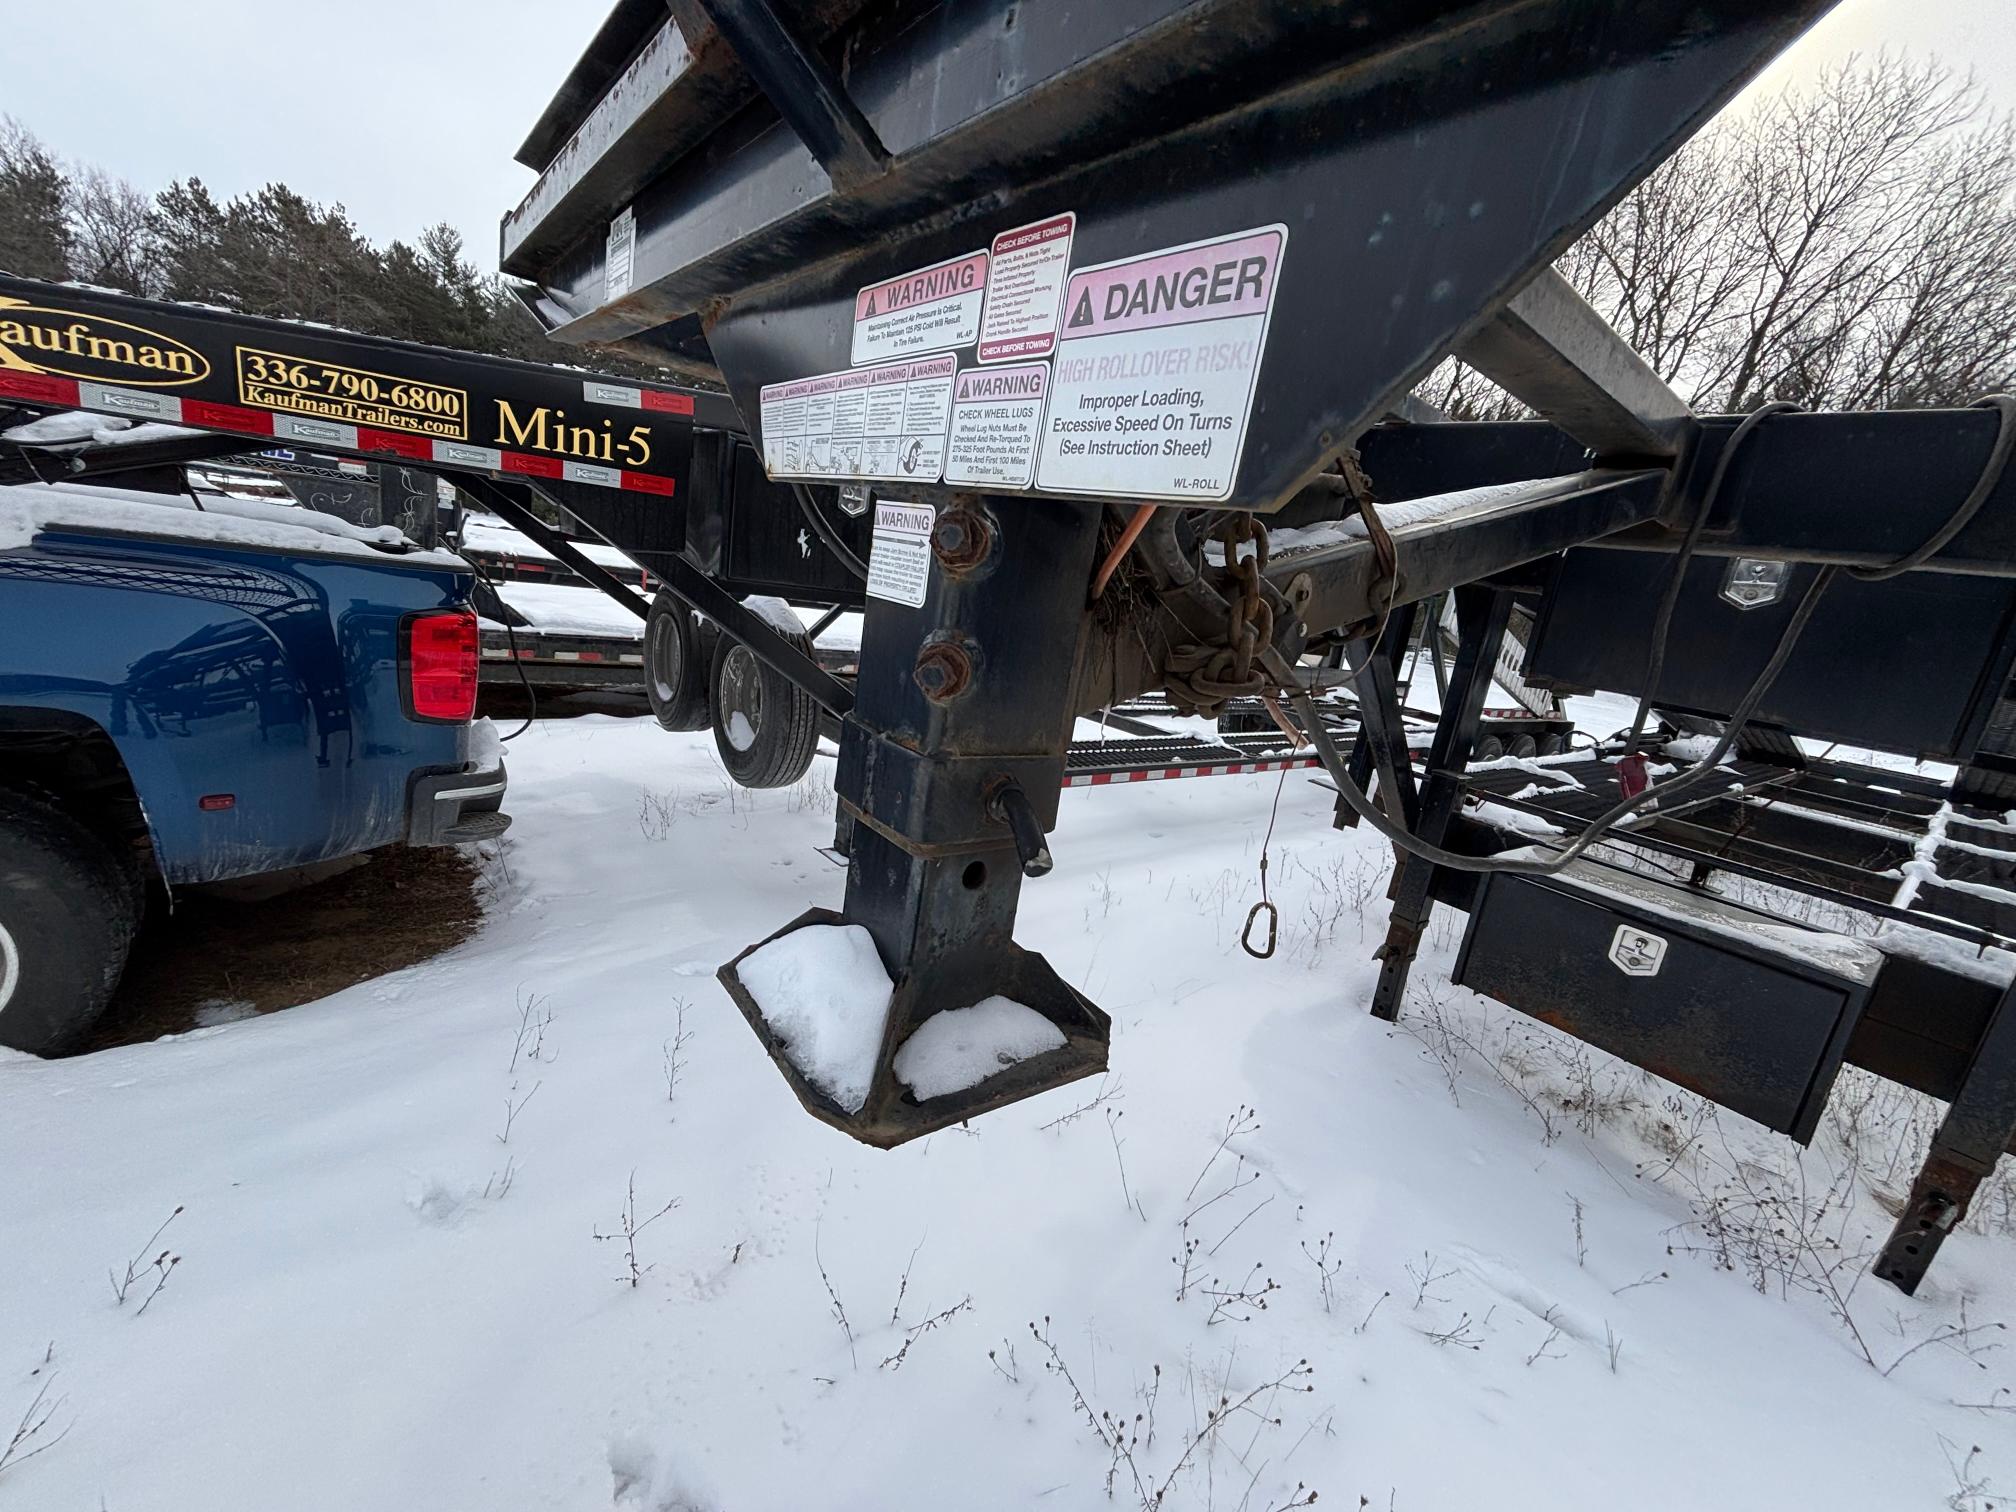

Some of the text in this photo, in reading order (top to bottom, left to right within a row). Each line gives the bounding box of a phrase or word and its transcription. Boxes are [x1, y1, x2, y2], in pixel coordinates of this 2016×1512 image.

[996, 223, 1068, 251] CHECK BEFORE TOWING
[887, 263, 975, 309] WARNING
[1104, 255, 1268, 321] DANGER
[891, 316, 908, 327] Correct
[916, 310, 936, 321] Pressure
[922, 320, 934, 330] Cold
[0, 305, 197, 375] aufman
[899, 338, 907, 346] Tire
[982, 338, 1050, 356] CHECK BEFORE TOWING
[917, 361, 952, 376] WARNING
[1057, 340, 1255, 385] HIGH ROLLOVER RISK!
[877, 368, 907, 382] WARNING
[246, 356, 460, 416] 336-790-6800
[972, 373, 1041, 397] WARNING
[103, 392, 159, 411] Kaufman
[1079, 388, 1205, 412] Improper Loading,
[246, 386, 461, 436] KaufmanTrailers.com
[958, 407, 1034, 420] CHECK WHEEL LUGS
[294, 424, 340, 439] Kaufman
[493, 398, 652, 466] Mini-5
[960, 423, 1027, 434] Wheel Lug Nuts Must Be
[1052, 413, 1233, 435] Excessive Speed On Turns
[954, 435, 976, 443] Checked
[977, 435, 988, 443] And
[1023, 435, 1031, 443] To
[1059, 437, 1212, 458] (See Instruction Sheet)
[973, 445, 985, 453] Foot
[985, 445, 1007, 454] Pounds
[1008, 446, 1015, 454] At
[1016, 445, 1029, 454] First
[974, 455, 985, 463] And
[985, 456, 998, 464] First
[1010, 457, 1026, 465] Miles
[967, 465, 975, 474] Of
[975, 465, 992, 474] Trailer
[1173, 478, 1220, 490] WL-ROLL
[881, 510, 930, 531] WARNING
